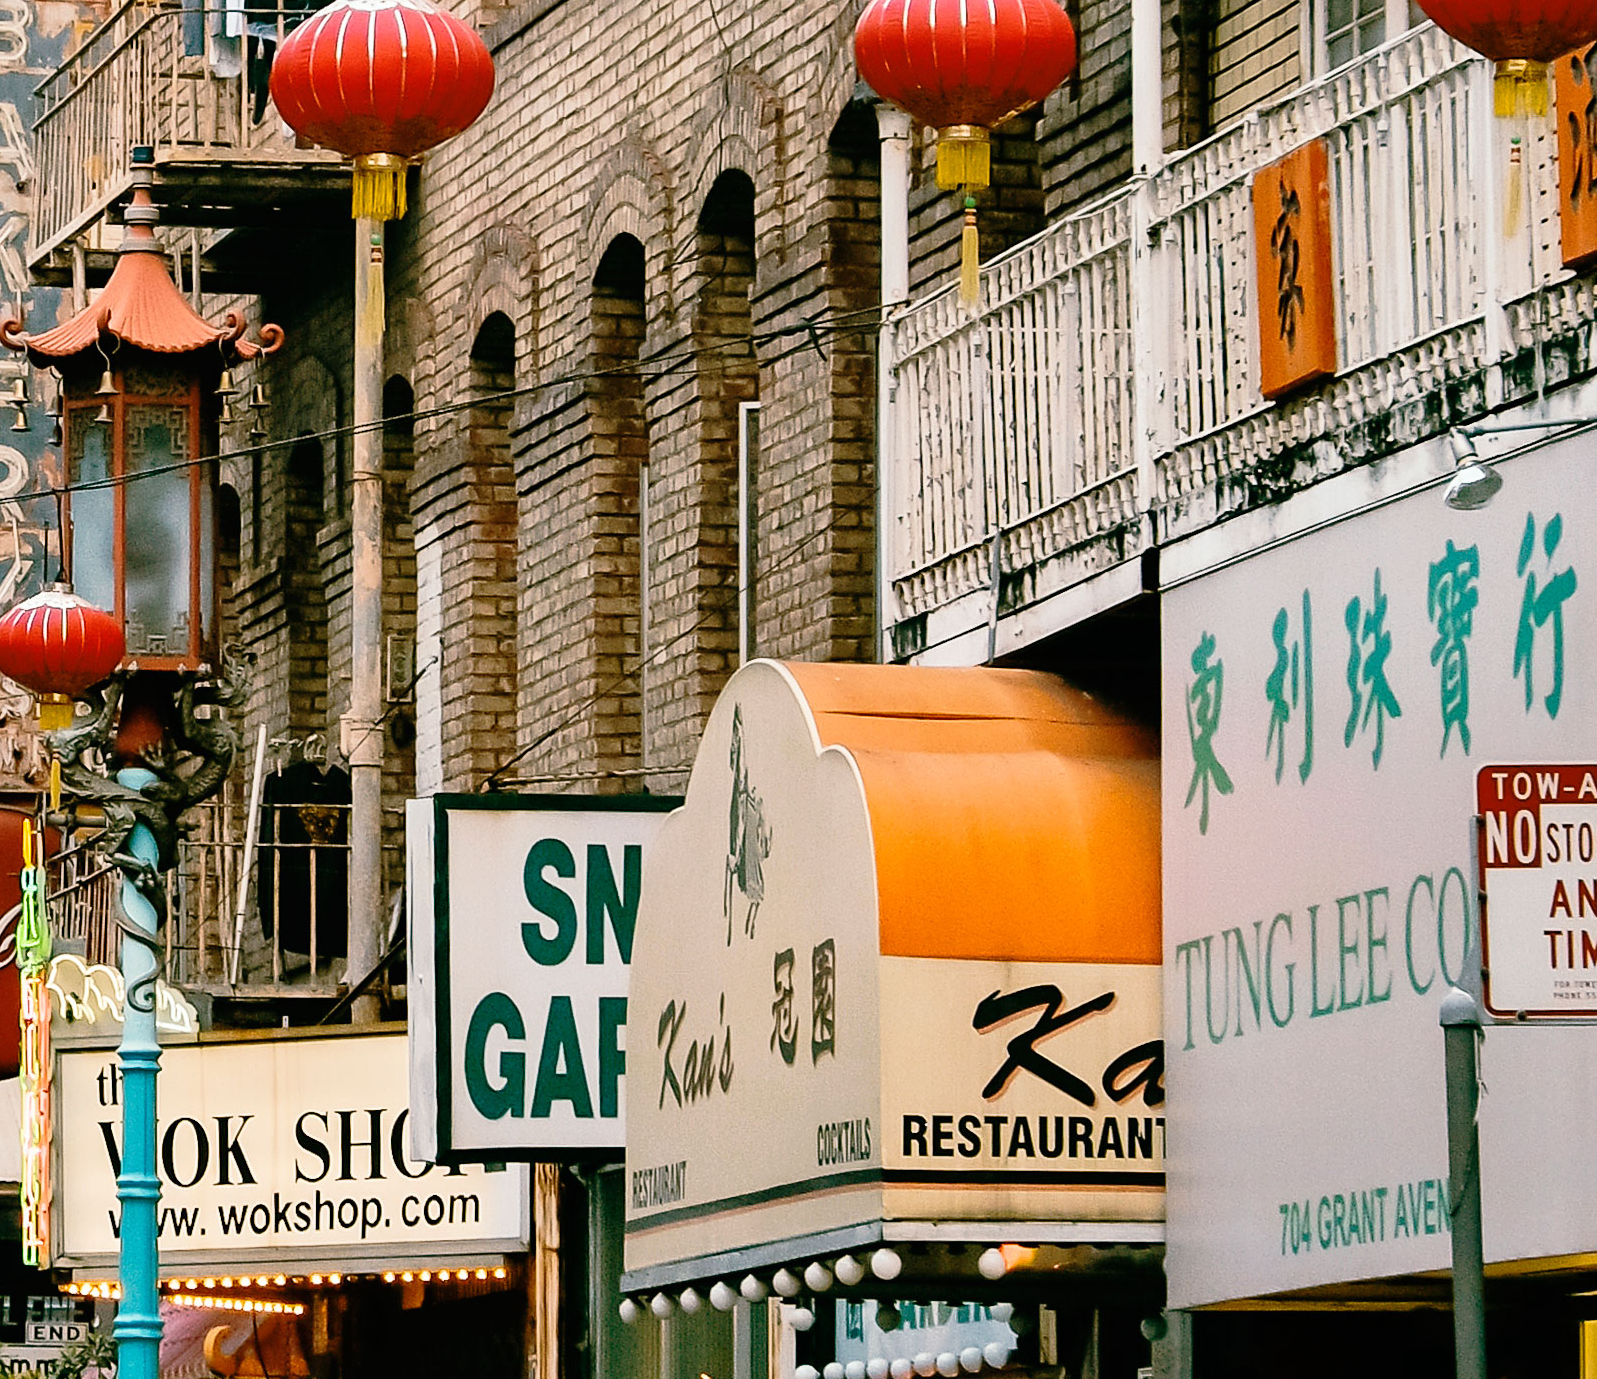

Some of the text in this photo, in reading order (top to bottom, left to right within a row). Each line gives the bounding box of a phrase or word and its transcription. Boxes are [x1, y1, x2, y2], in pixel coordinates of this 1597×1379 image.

[1184, 510, 1579, 836] 東利珠寶行
[1485, 809, 1537, 864] NO
[769, 938, 836, 1068] 冠園
[1175, 914, 1296, 1052] TUNG
[1307, 885, 1393, 1019] LEE
[658, 990, 735, 1110] Kan's
[817, 1117, 872, 1166] COCKTAILS
[632, 1160, 688, 1210] RESTAURANT
[1278, 1199, 1313, 1256] 704
[1317, 1184, 1391, 1248] GRANT
[34, 1326, 80, 1341] END
